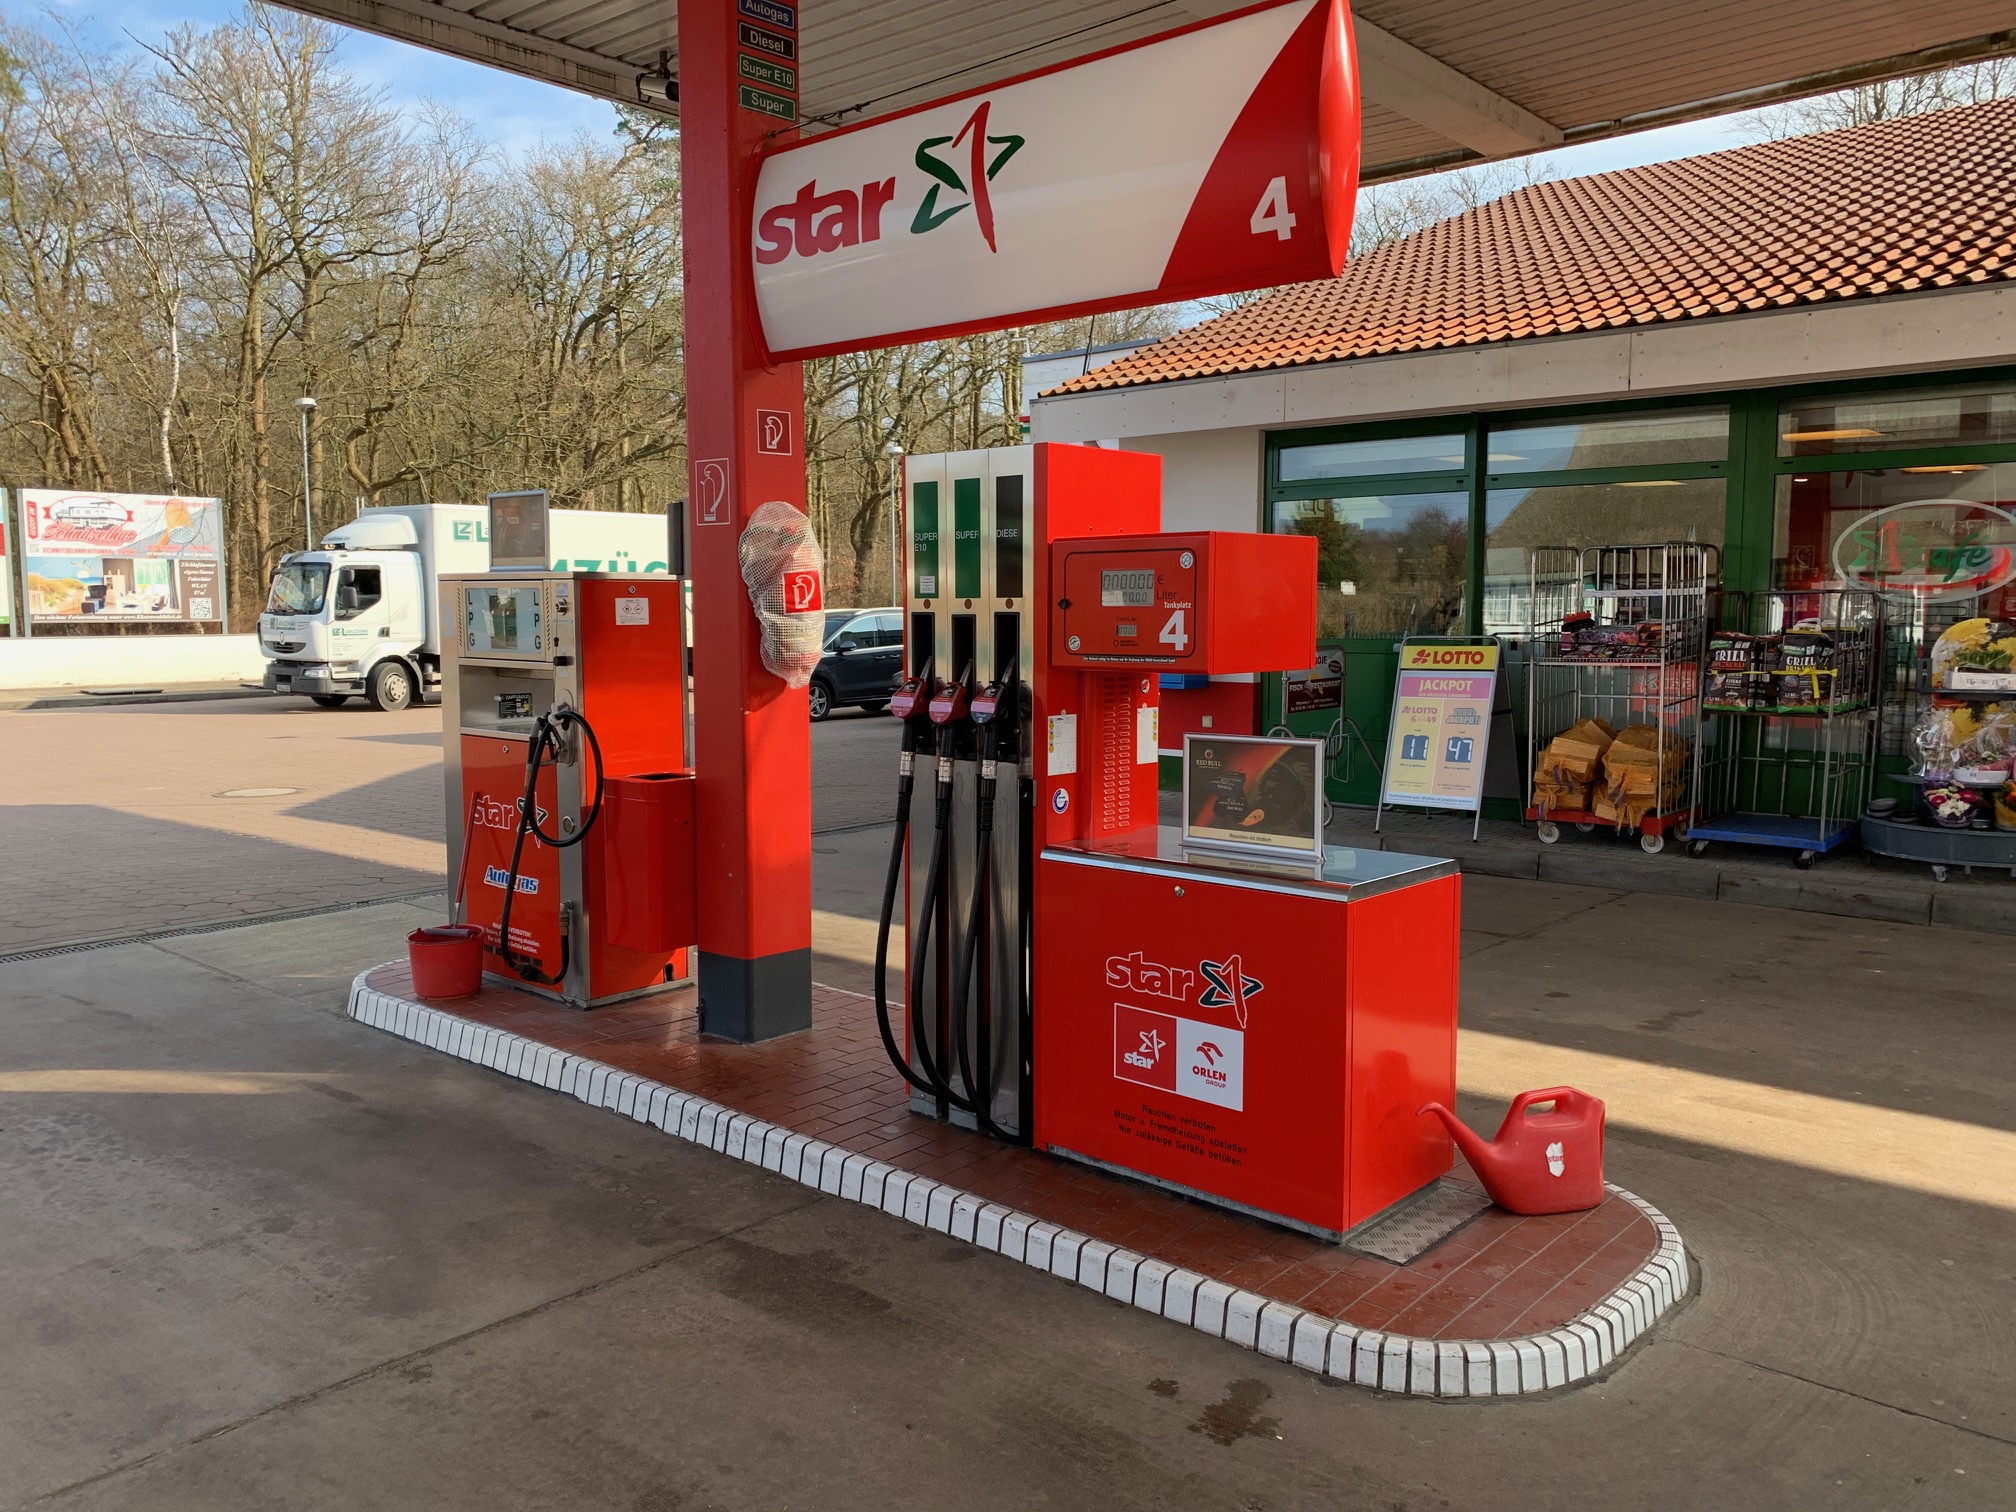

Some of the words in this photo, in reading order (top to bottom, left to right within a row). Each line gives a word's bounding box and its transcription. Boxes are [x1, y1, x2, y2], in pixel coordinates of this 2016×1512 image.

[745, 0, 789, 22] Autogas
[750, 31, 784, 52] Diesel
[742, 60, 772, 79] Super
[774, 69, 793, 85] E10
[751, 93, 785, 112] Super
[1250, 176, 1297, 241] 4
[755, 176, 896, 265] star
[914, 532, 938, 541] SUPER
[914, 543, 927, 552] E10
[1156, 590, 1178, 600] Liter
[1164, 601, 1191, 609] Tankplatz
[1159, 610, 1188, 651] 4
[1432, 651, 1484, 665] LOTTO
[1786, 656, 1816, 666] GRILL
[1419, 680, 1473, 692] JACKPOT
[1412, 706, 1438, 714] LOTTO
[1445, 716, 1481, 725] JACKPOT
[1448, 739, 1473, 761] 47
[474, 795, 513, 830] star
[1229, 833, 1249, 841] Rauchen
[1256, 835, 1271, 843] tödlich
[1106, 951, 1194, 1001] star
[1123, 1051, 1155, 1070] star
[1192, 1065, 1227, 1083] ORLEN
[1205, 1079, 1227, 1089] GROUP
[1142, 1104, 1176, 1121] Rauchen
[1180, 1115, 1216, 1132] verboten
[1114, 1109, 1137, 1122] Motor
[1149, 1120, 1205, 1144] Fremdheizung
[1209, 1137, 1248, 1155] abstellen
[1119, 1123, 1131, 1134] Nur
[1135, 1129, 1172, 1147] zulässige
[1175, 1140, 1204, 1156] Gefäße
[1208, 1150, 1242, 1167] befüllen
